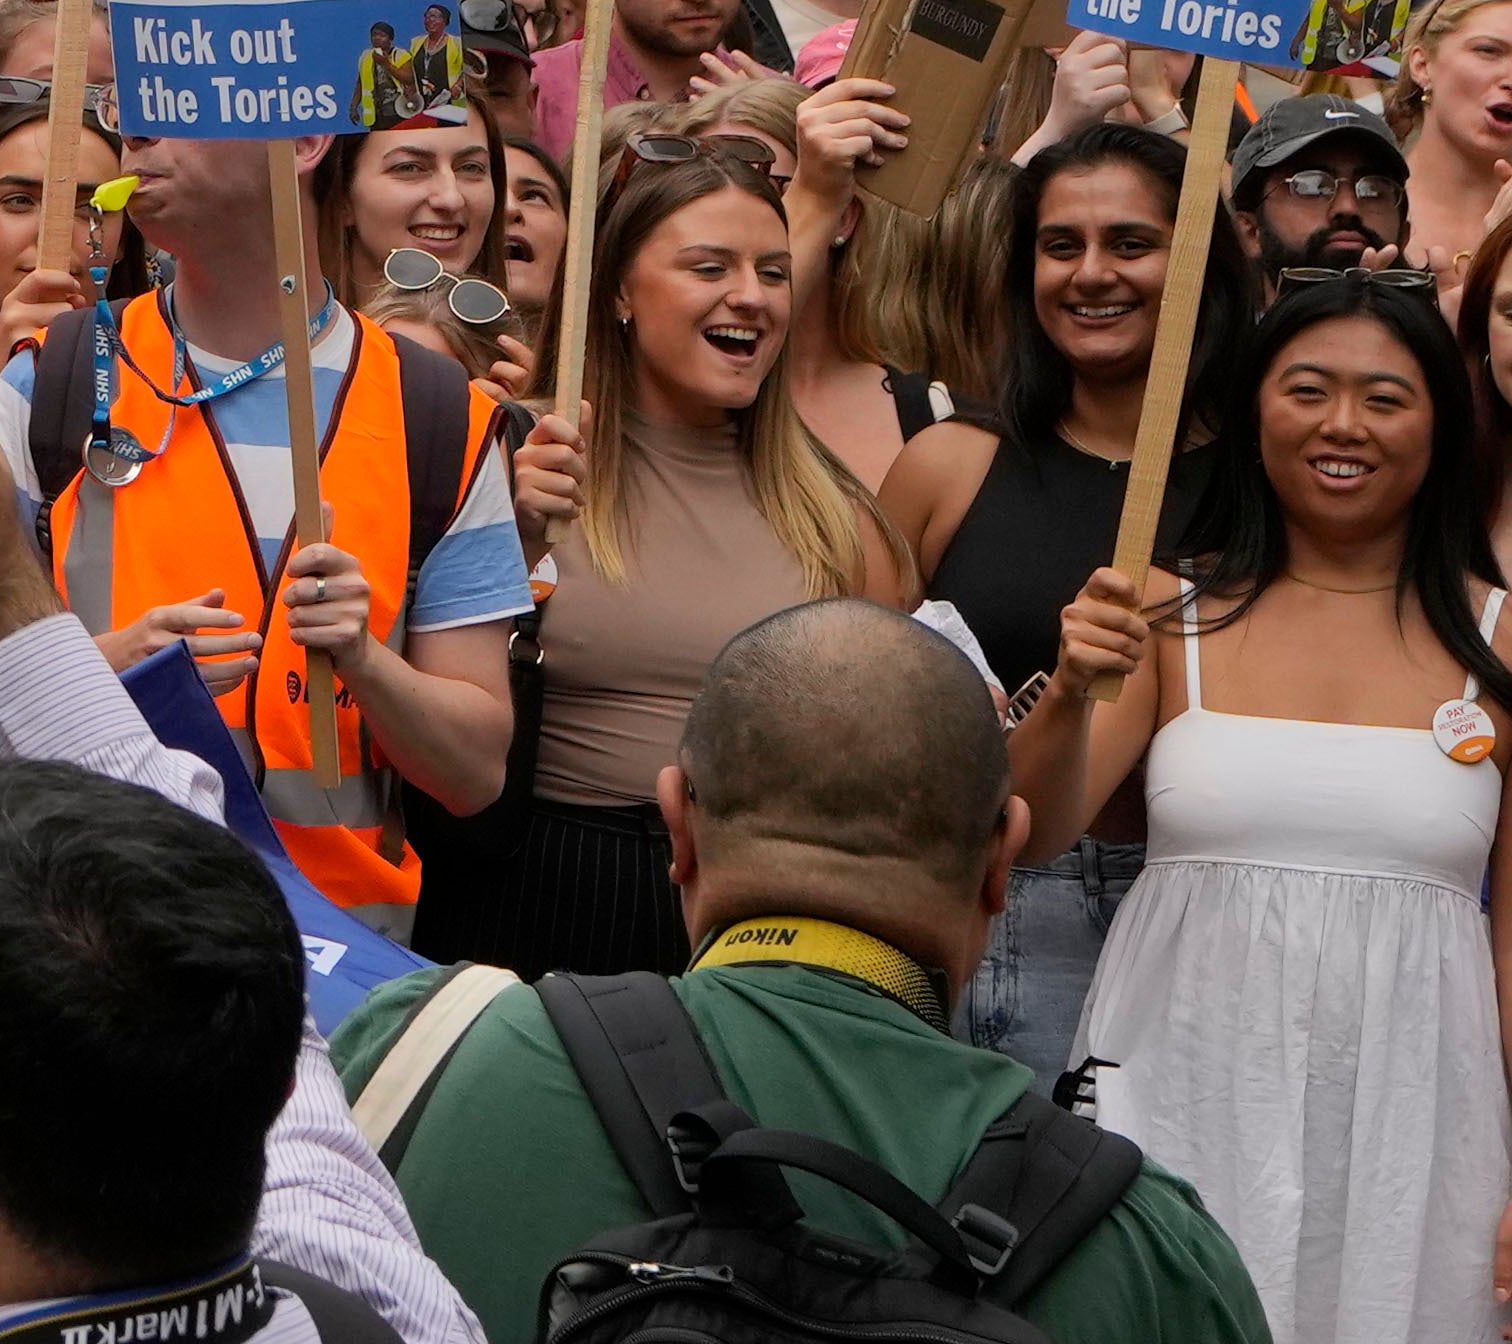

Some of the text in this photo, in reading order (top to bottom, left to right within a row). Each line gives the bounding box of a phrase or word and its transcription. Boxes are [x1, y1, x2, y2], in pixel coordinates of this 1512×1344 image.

[133, 17, 297, 65] Kick out
[138, 73, 338, 123] the Tories
[95, 324, 110, 357] NHS
[95, 368, 110, 404] NHS
[109, 437, 140, 462] NHS
[1446, 706, 1464, 718] PAY
[1452, 722, 1476, 737] NOW
[725, 928, 799, 946] Nikon
